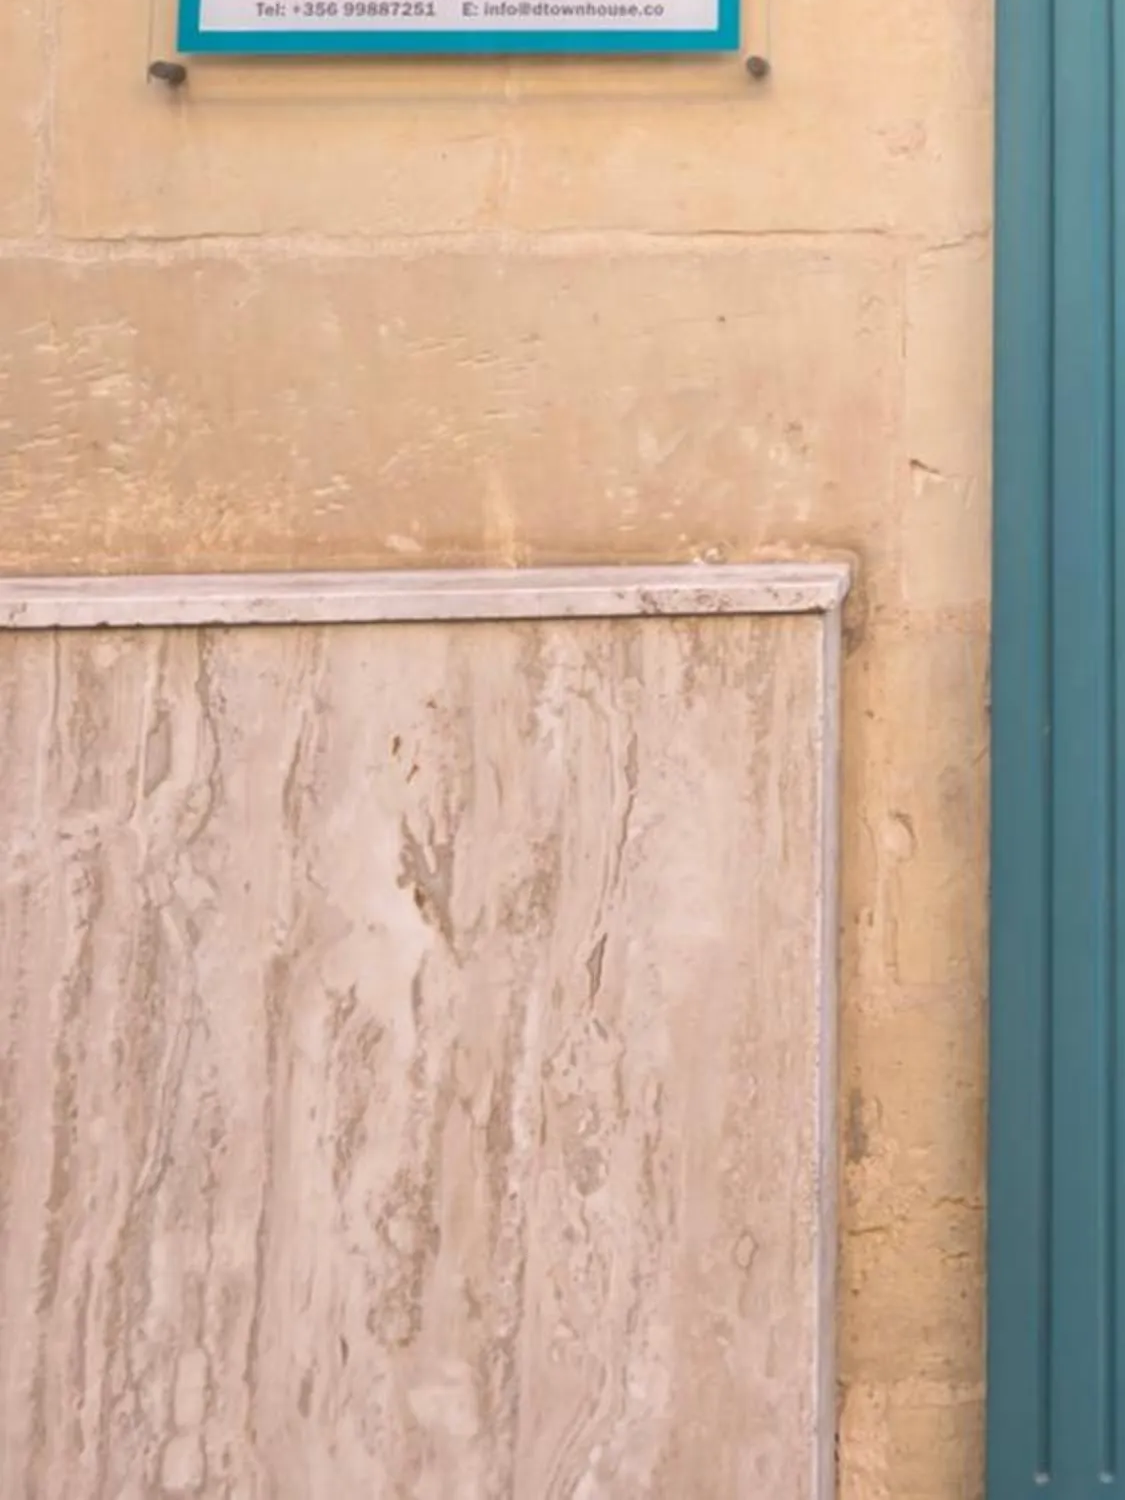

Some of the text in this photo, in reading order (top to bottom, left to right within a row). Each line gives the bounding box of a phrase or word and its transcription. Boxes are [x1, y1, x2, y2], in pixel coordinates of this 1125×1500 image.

[256, 2, 664, 17] Tel: +356 99887251 E: info@dtownhouse.co
